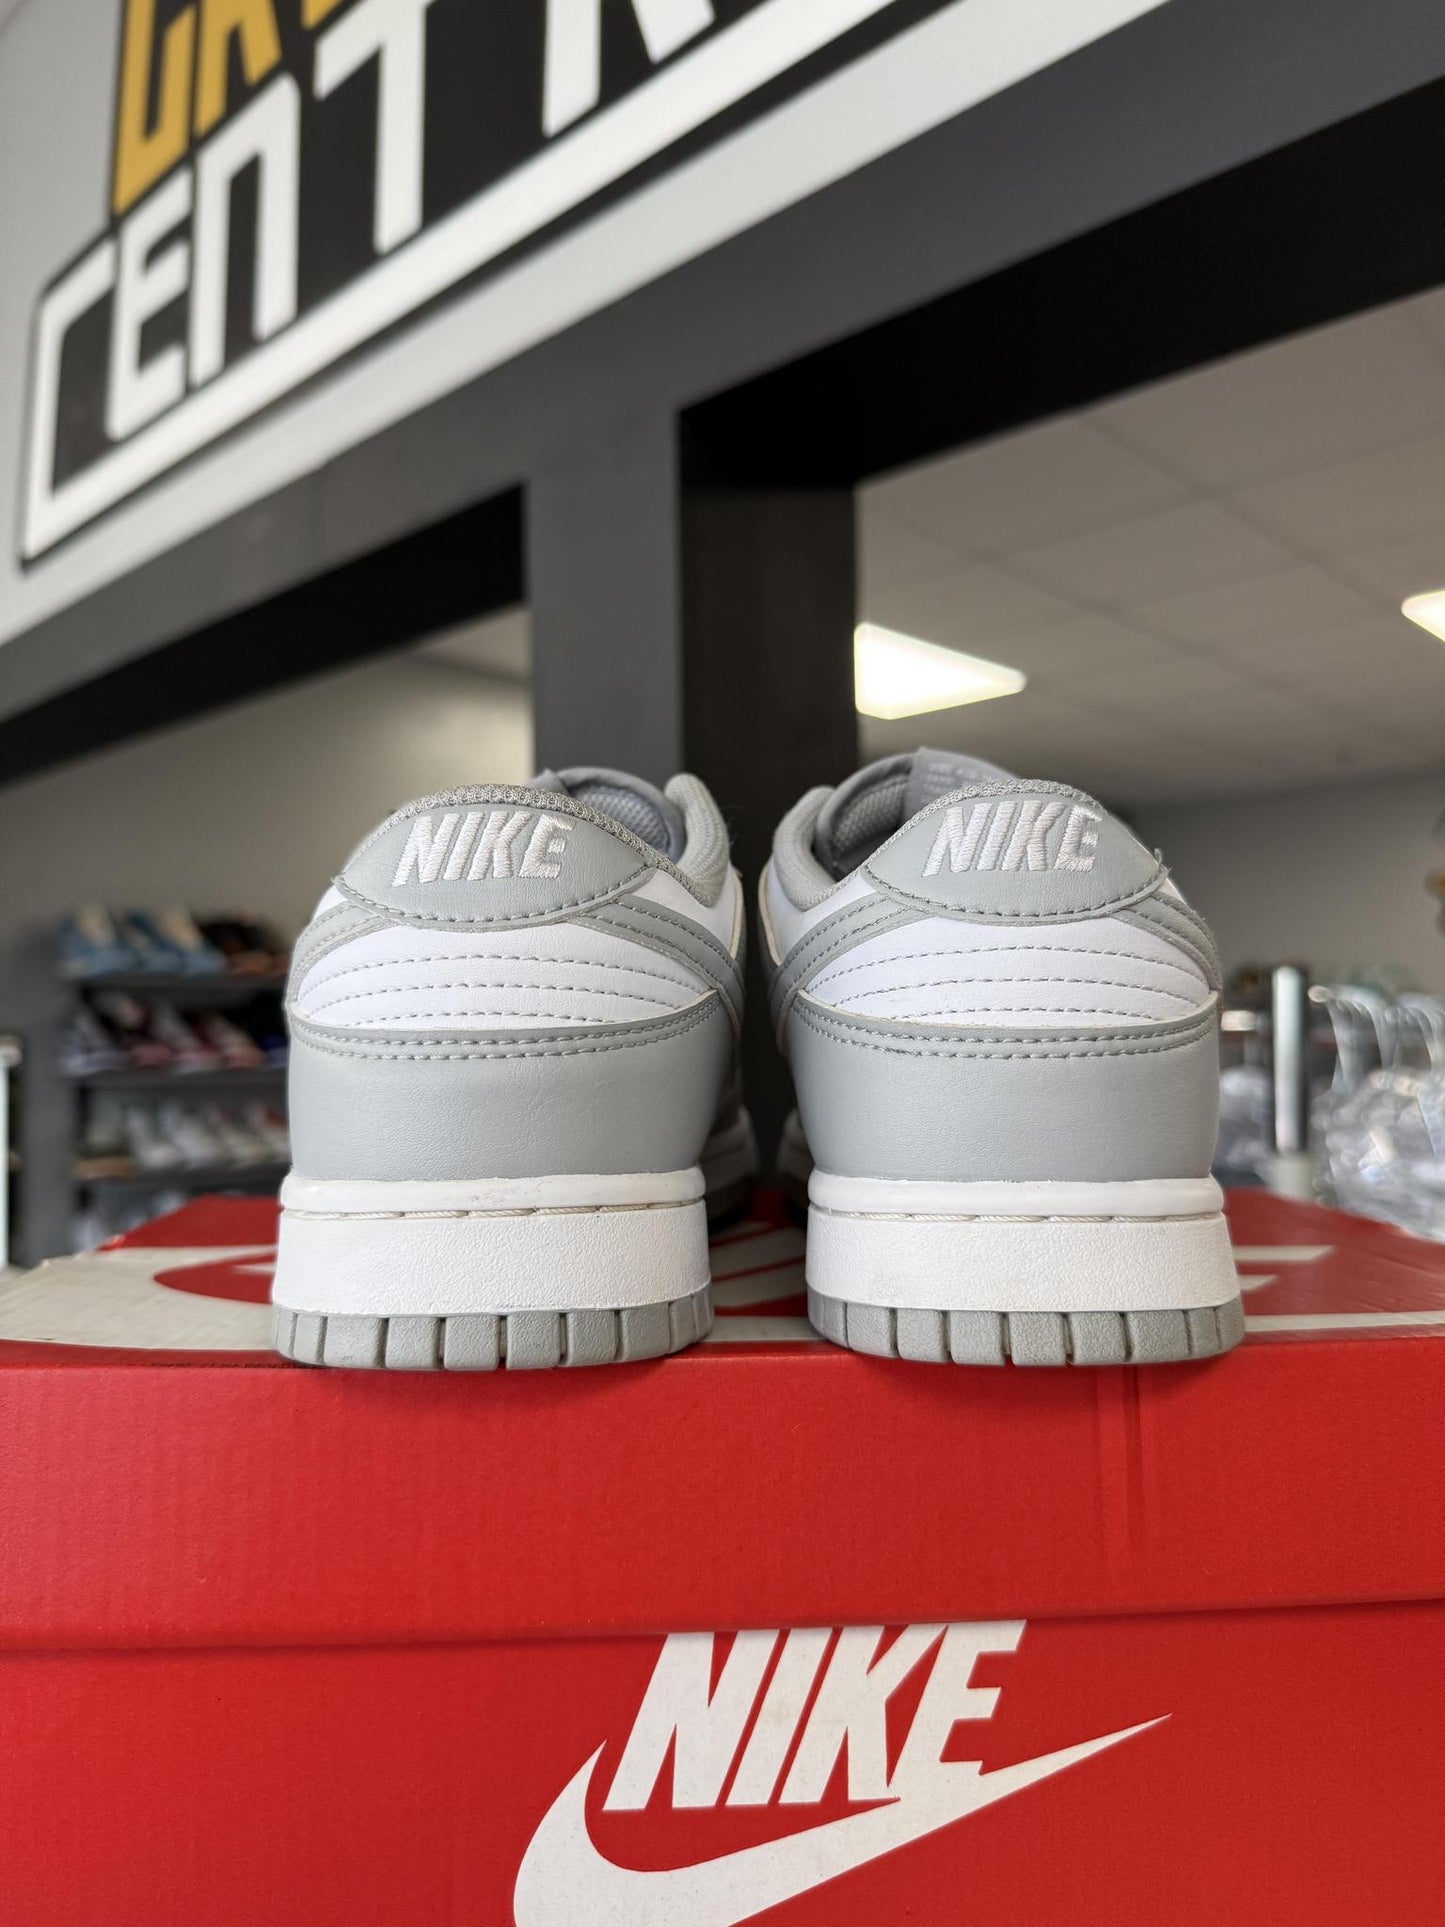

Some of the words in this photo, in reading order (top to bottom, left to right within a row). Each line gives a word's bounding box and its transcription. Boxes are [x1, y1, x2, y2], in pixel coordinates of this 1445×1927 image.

[392, 811, 576, 887] NIKE
[921, 800, 1102, 877] NIKE
[602, 1619, 1027, 1812] NIKE
